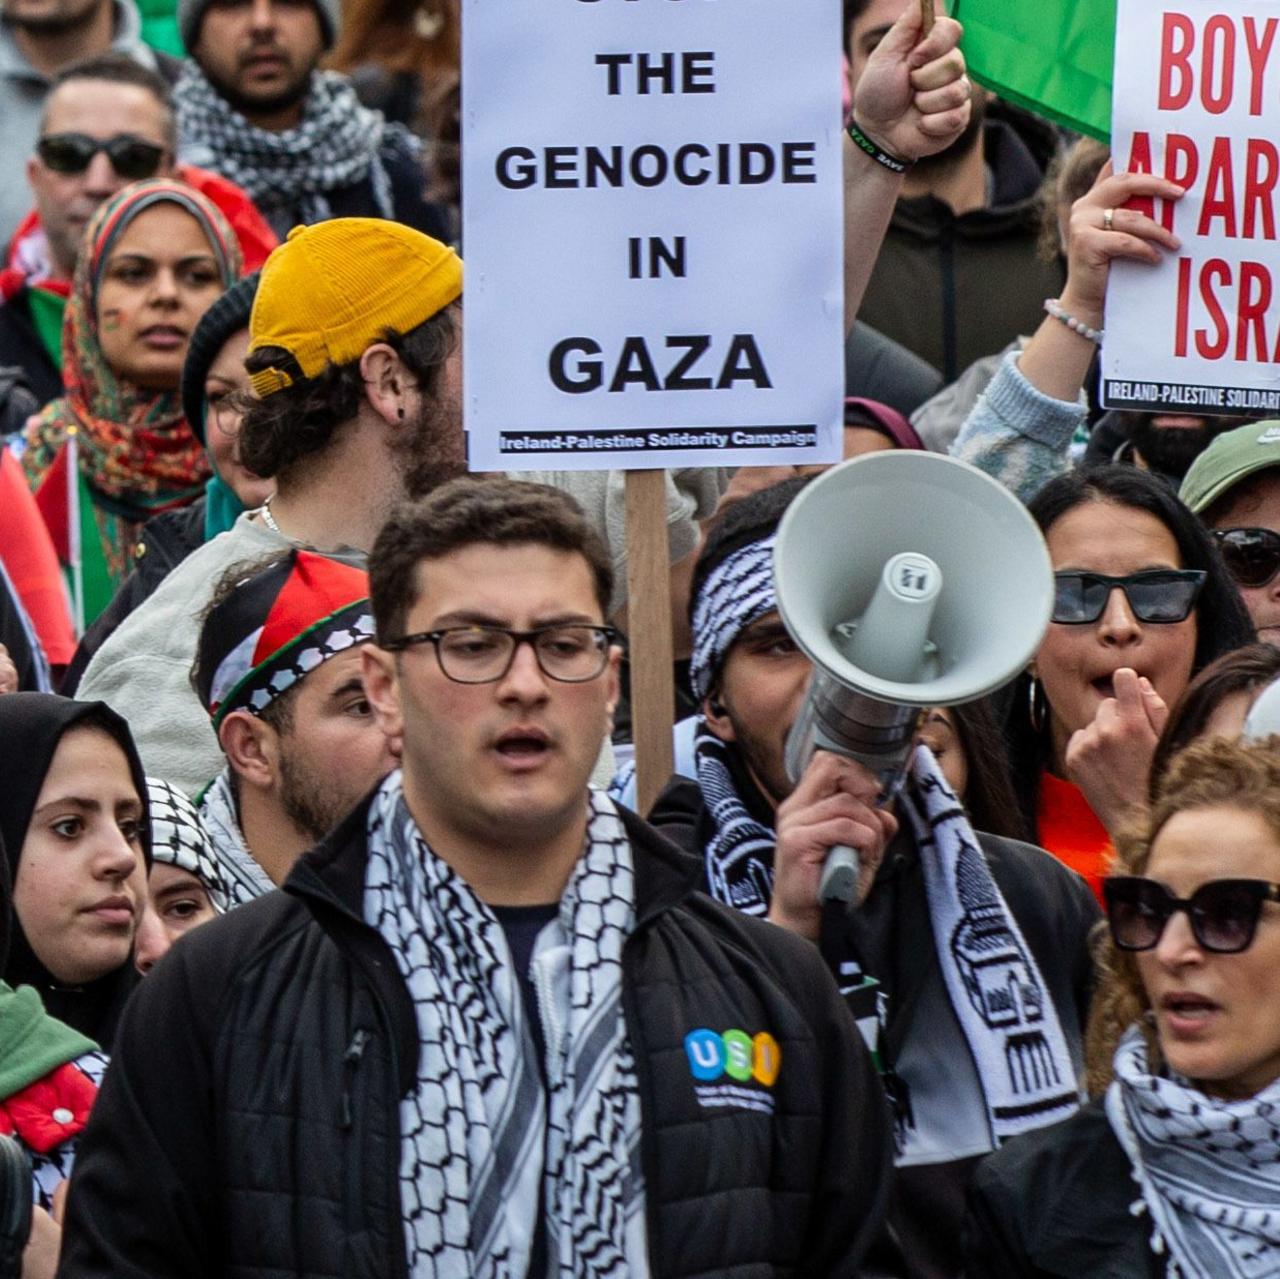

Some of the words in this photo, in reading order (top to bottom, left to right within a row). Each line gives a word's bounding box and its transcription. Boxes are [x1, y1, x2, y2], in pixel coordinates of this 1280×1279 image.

[595, 51, 716, 95] THE
[851, 128, 875, 153] GAZA
[495, 142, 817, 189] GENOCIDE
[628, 236, 687, 279] IN
[1174, 257, 1280, 364] ISR
[548, 334, 774, 394] GAZA
[1108, 381, 1224, 407] IRELAND-PALESTINE
[500, 435, 645, 451] Ireland-Palestine
[648, 432, 729, 448] Solidarity
[731, 430, 816, 447] Campaign
[687, 1034, 776, 1079] USI
